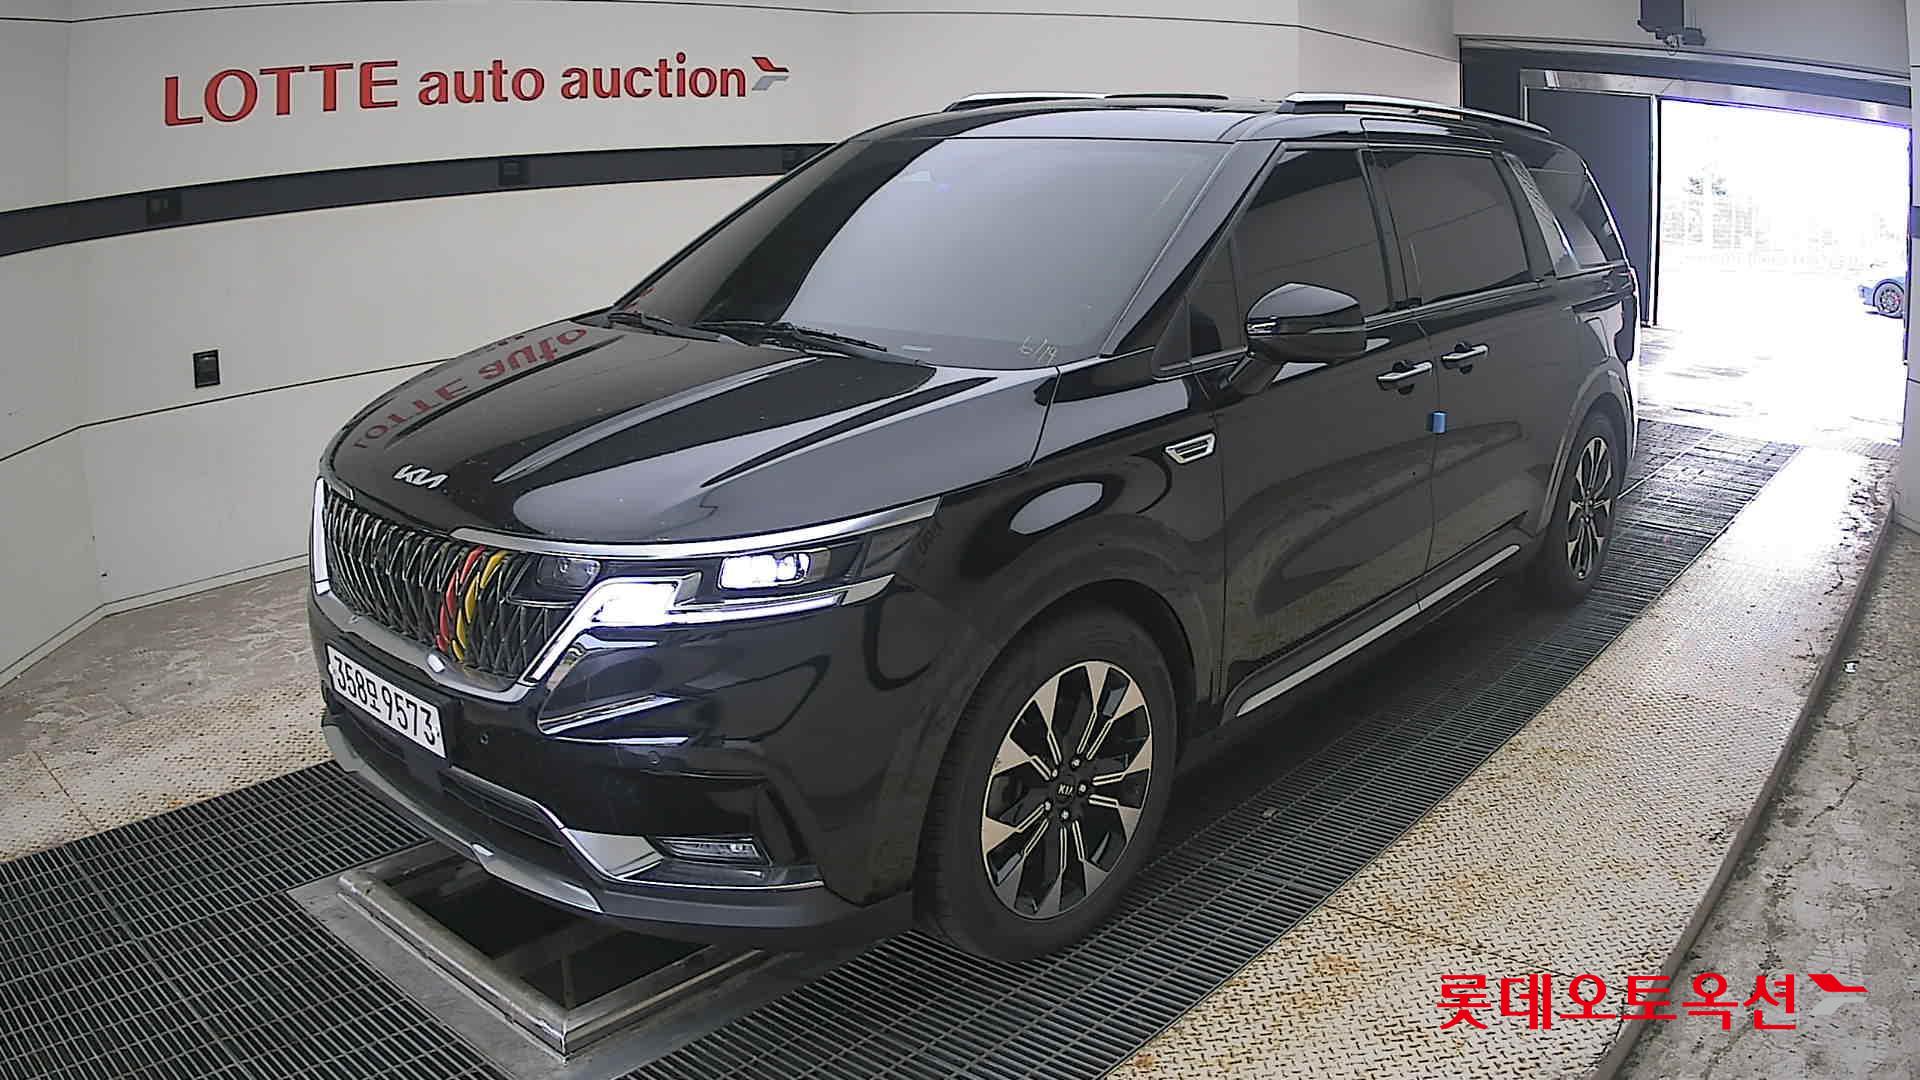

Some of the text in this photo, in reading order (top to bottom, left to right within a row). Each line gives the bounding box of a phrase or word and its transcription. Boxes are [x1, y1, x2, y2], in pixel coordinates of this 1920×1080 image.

[164, 51, 748, 126] LOTTE auto auction
